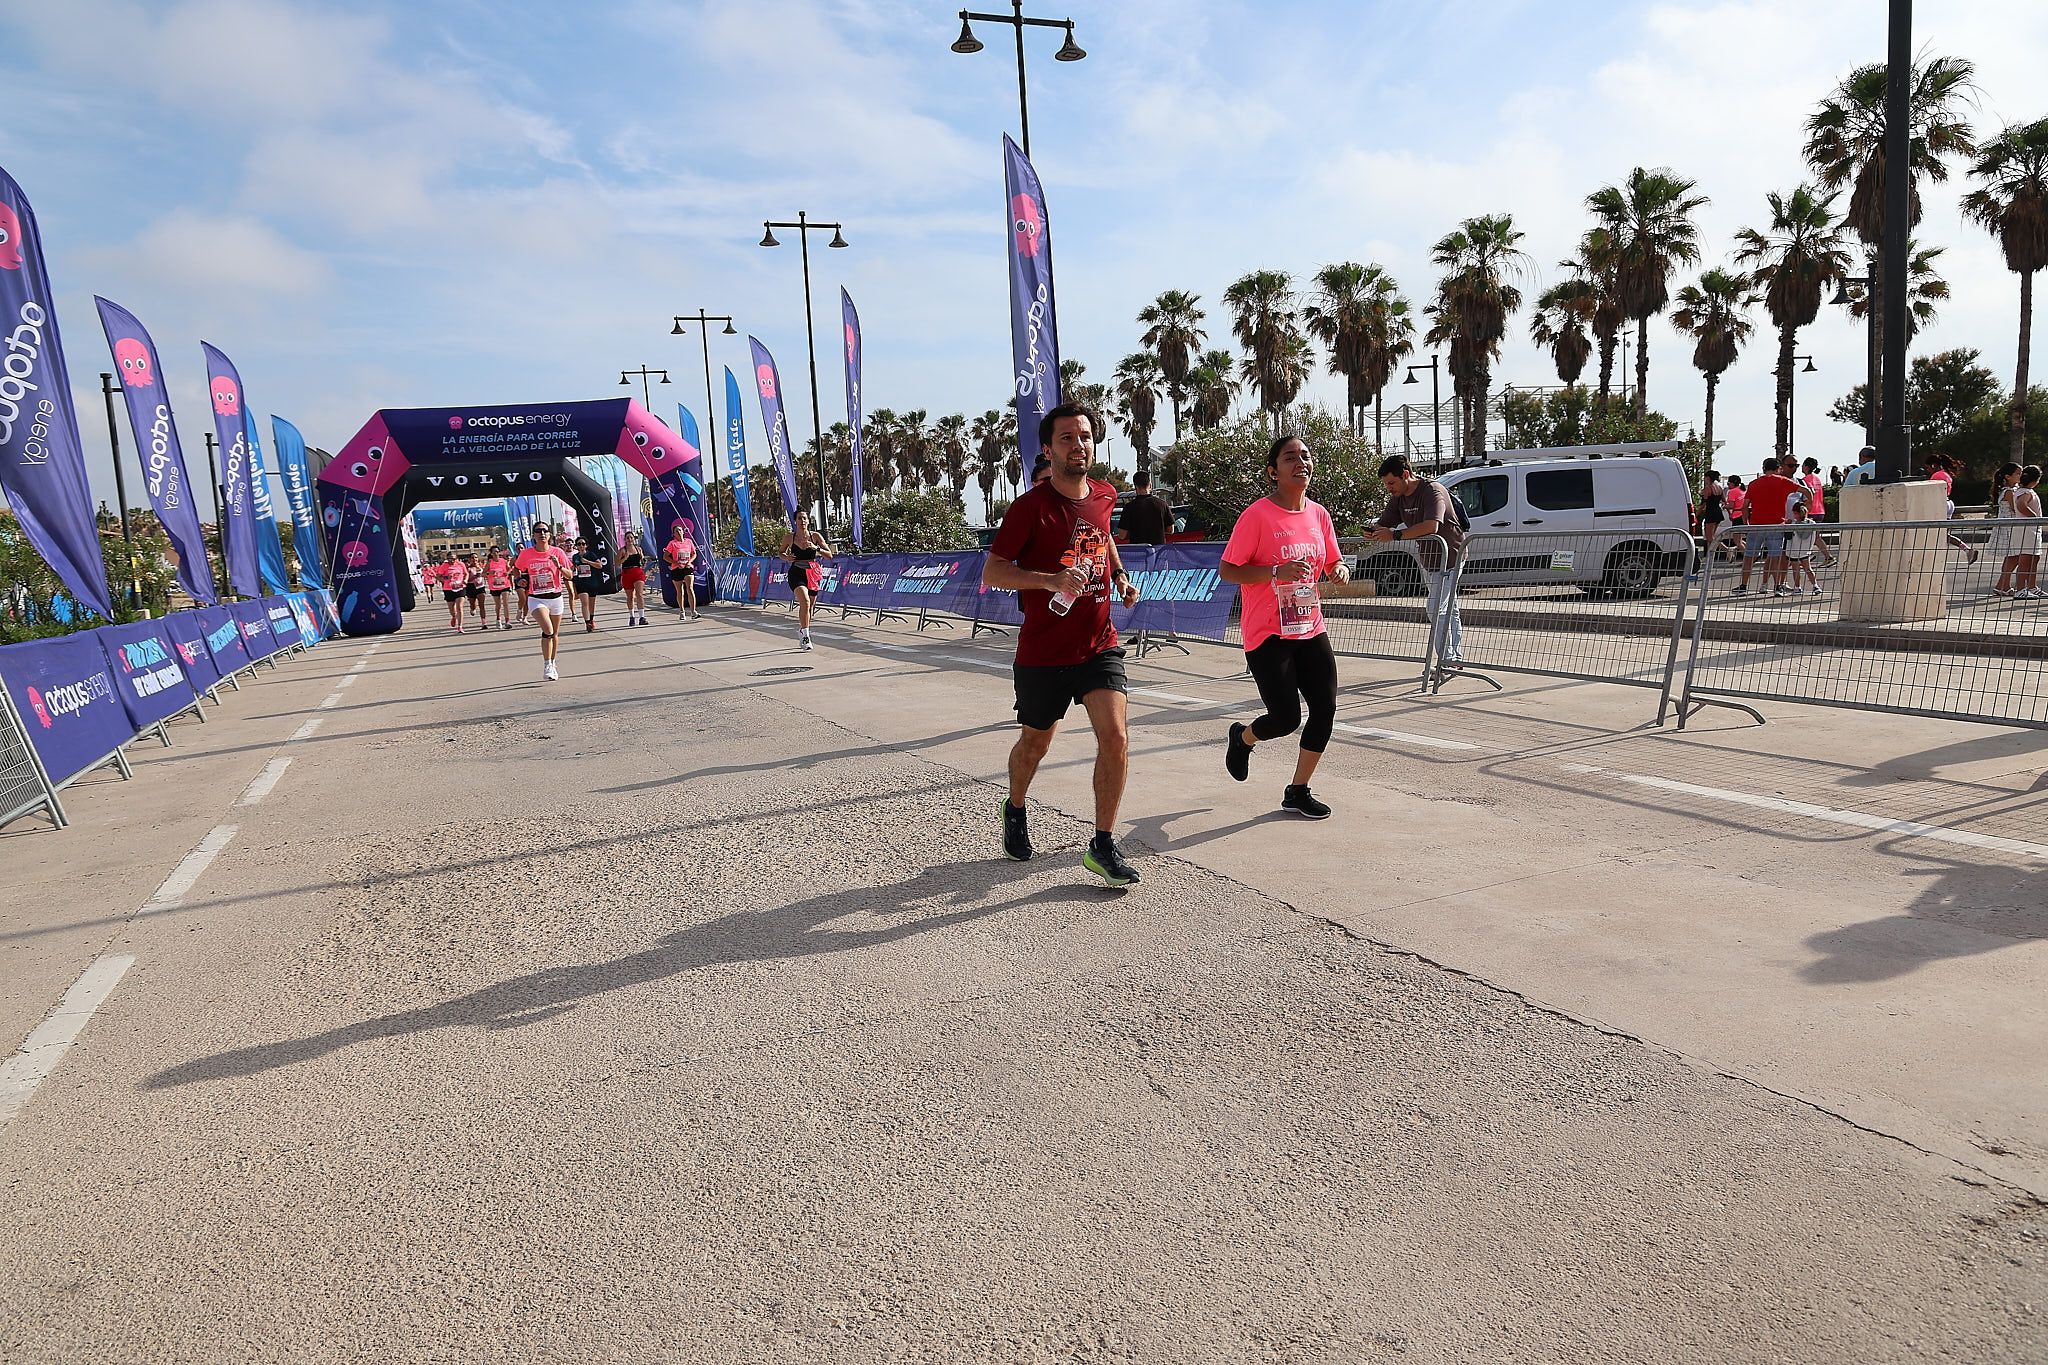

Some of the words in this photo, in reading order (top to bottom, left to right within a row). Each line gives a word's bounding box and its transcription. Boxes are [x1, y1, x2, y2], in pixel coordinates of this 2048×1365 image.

[467, 415, 525, 428] octopus
[525, 413, 572, 427] energy
[442, 436, 456, 444] LA
[458, 432, 505, 444] ENERGÍA
[506, 432, 535, 442] PARA
[537, 430, 579, 440] CORRER
[452, 446, 466, 454] LA
[469, 443, 528, 453] VELOCIDAD
[561, 440, 581, 448] LUZ
[426, 471, 543, 487] VOLVO
[1280, 542, 1322, 560] CARRERA
[44, 681, 91, 718] octopus
